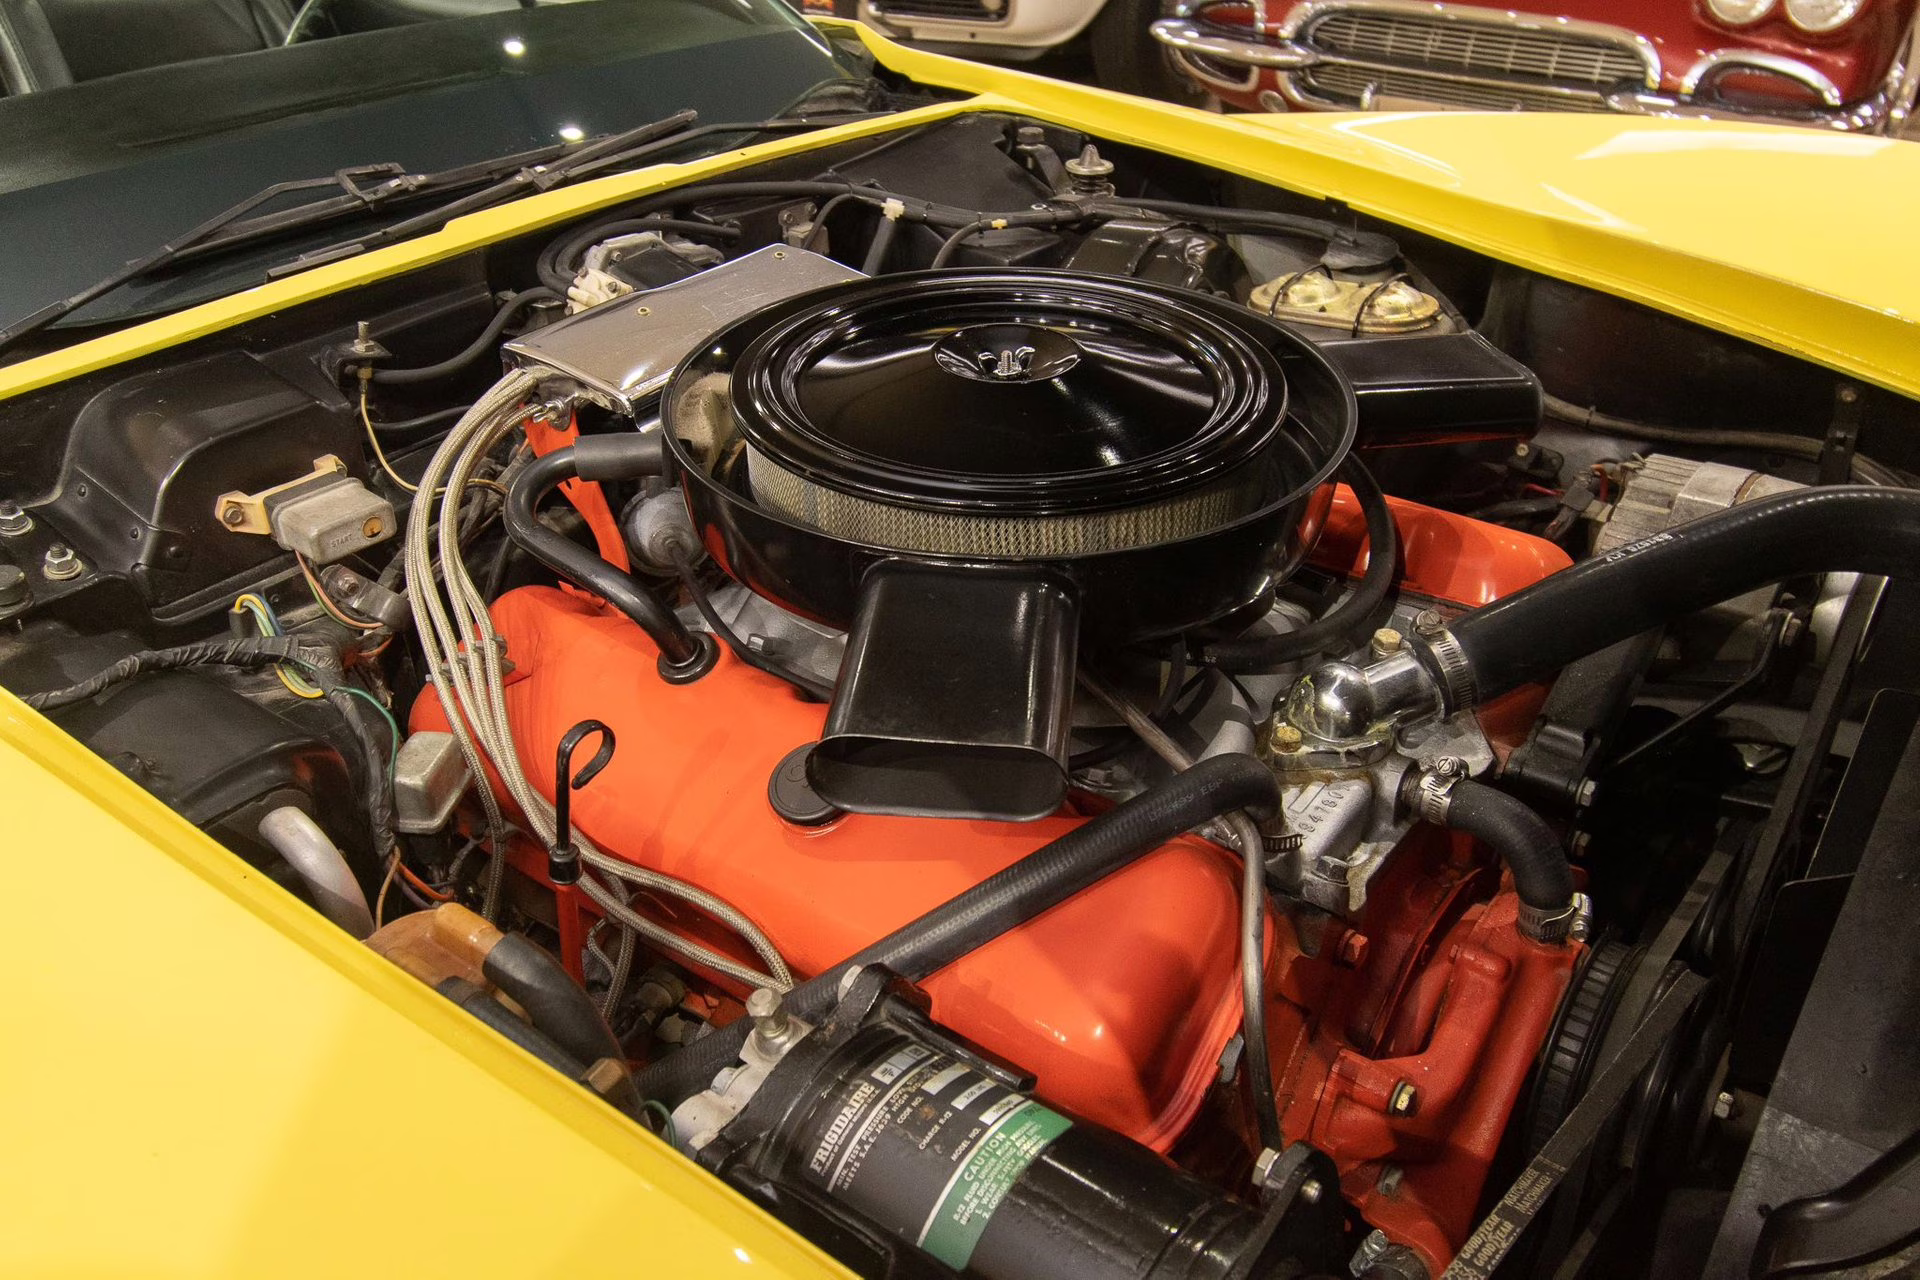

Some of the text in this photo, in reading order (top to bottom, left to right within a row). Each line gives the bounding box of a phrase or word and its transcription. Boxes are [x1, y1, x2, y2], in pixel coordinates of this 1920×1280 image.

[330, 533, 352, 547] START
[810, 1080, 875, 1173] FRIGIDAIRE
[846, 1145, 861, 1163] TEST
[861, 1104, 889, 1141] PRESSURE
[896, 1094, 924, 1124] CODE NO.
[917, 1123, 941, 1150] CHARGE
[841, 1160, 860, 1190] MEETS
[891, 1093, 909, 1112] HIGH
[950, 1126, 982, 1161] MODEL NO.
[962, 1130, 1006, 1183] CAUTION
[959, 1196, 980, 1225] BEFORE
[976, 1146, 1016, 1197] DISCONNECTING
[963, 1180, 980, 1202] FLUID
[978, 1156, 997, 1180] UNDER
[995, 1139, 1013, 1157] HIGH
[980, 1182, 999, 1206] WEAR
[997, 1157, 1017, 1181] SAFETY
[987, 1176, 1012, 1210] CONSULT
[1461, 1213, 1501, 1260] GOODYEAR
[1503, 1166, 1539, 1206] MATCHMAKER
[1472, 1218, 1515, 1267] GOODYEAR
[1514, 1173, 1552, 1213] MATCHMAKER
